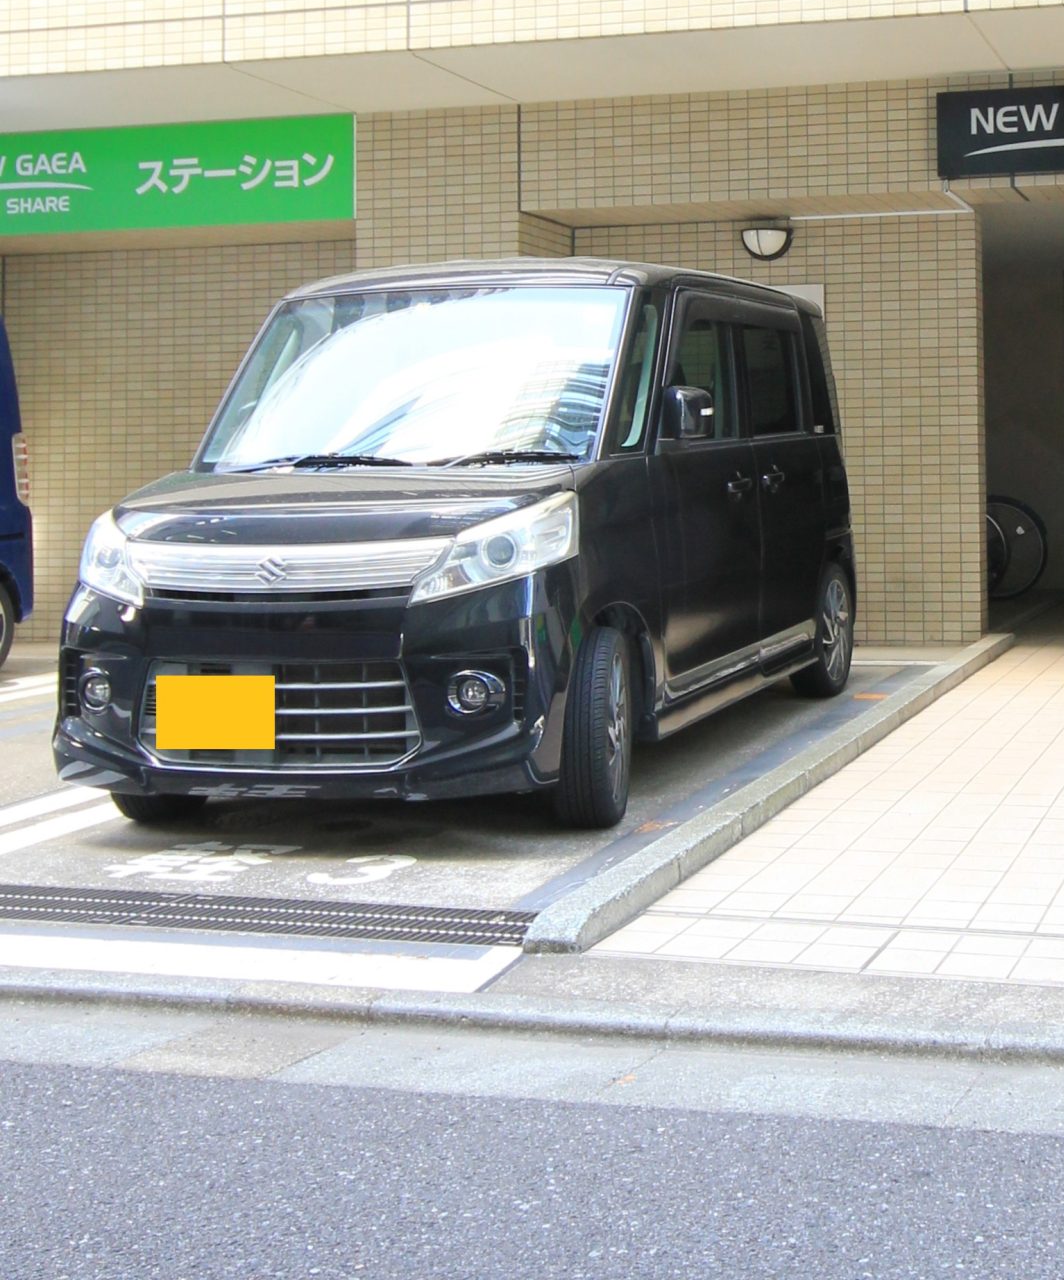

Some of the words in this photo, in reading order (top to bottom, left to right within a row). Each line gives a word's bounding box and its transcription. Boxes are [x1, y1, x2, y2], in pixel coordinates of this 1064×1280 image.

[969, 103, 1059, 135] NEW
[15, 152, 87, 176] GAEA
[135, 153, 335, 195] ステーション
[6, 195, 70, 214] SHARE
[306, 853, 417, 885] 3
